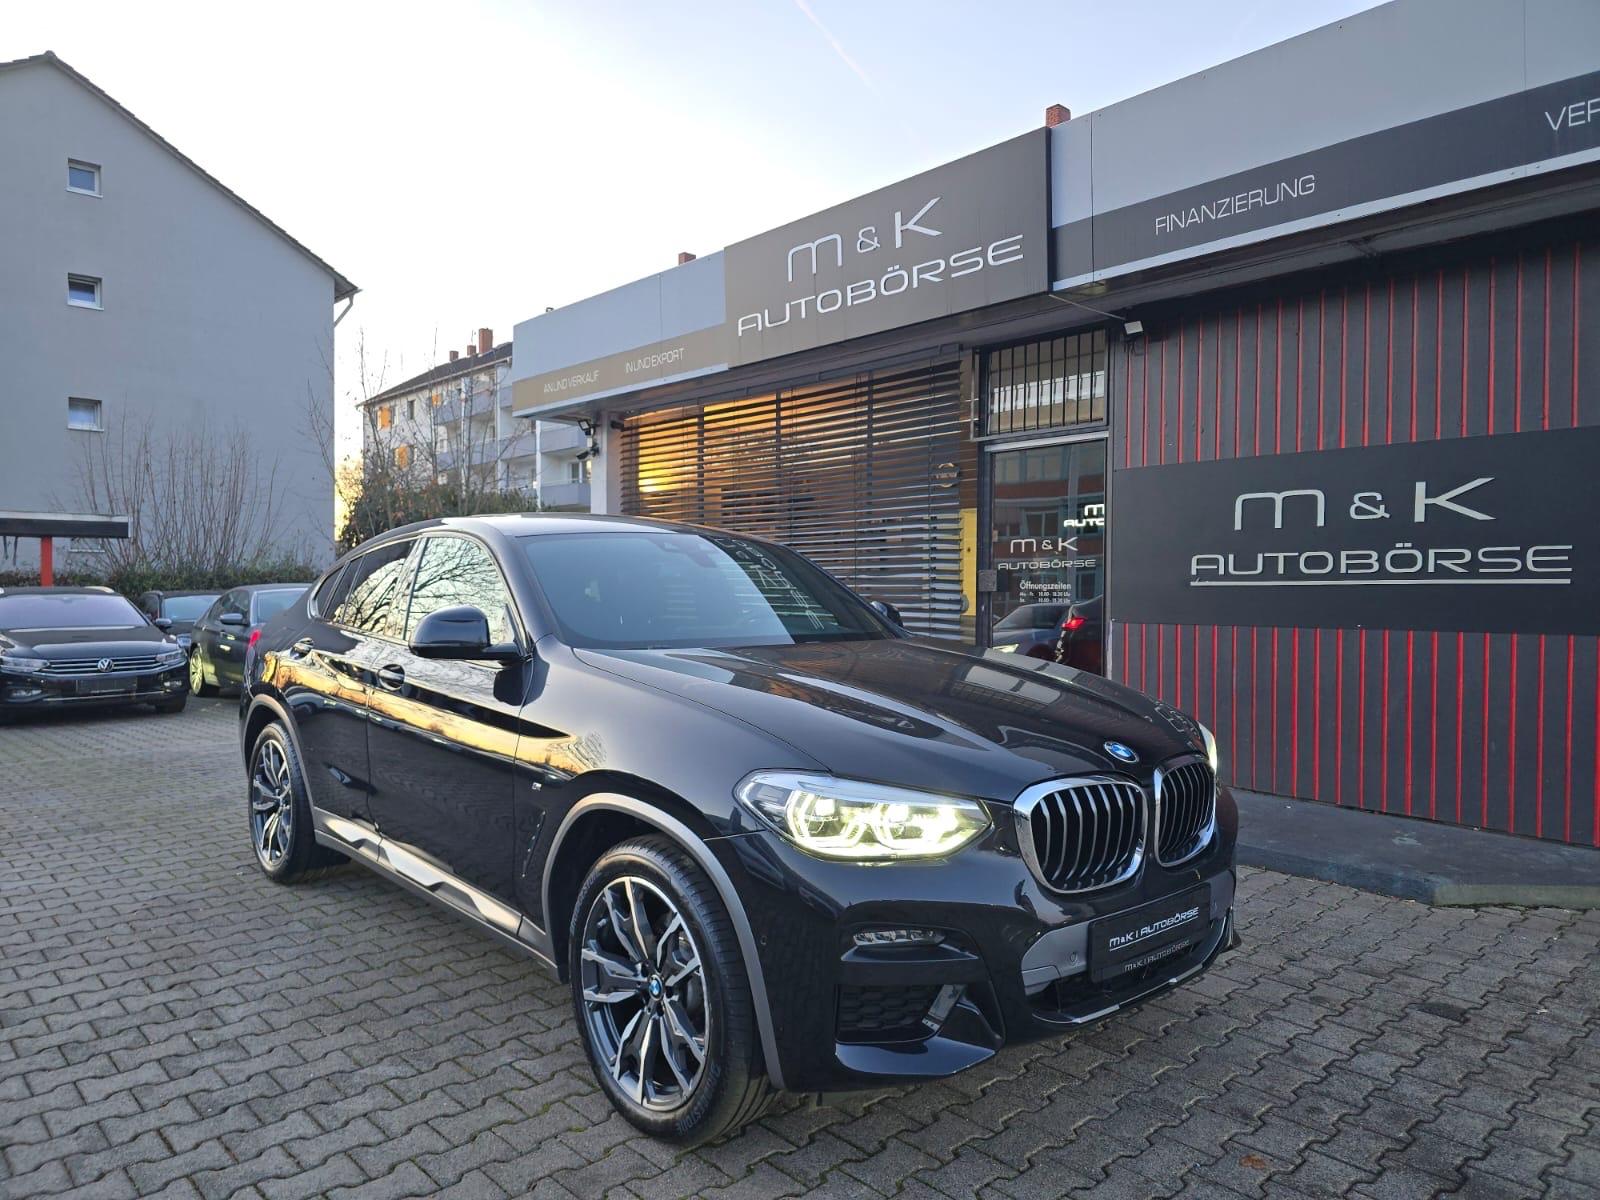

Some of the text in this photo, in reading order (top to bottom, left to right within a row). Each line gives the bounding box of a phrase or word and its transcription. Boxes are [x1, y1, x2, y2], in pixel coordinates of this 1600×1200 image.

[1155, 174, 1316, 236] FINANZIERUNG
[856, 226, 881, 253] &
[894, 196, 943, 249] K
[738, 234, 1024, 337] AUTOBÖRSE
[651, 347, 685, 368] EXPORT
[568, 369, 600, 388] VERKAUF
[1349, 491, 1391, 520] &
[1413, 477, 1497, 523] K
[1041, 539, 1054, 550] &
[1058, 536, 1079, 552] K
[1191, 542, 1573, 575] AUTOBÖRSE
[998, 559, 1097, 571] AUTOBÖRSE
[1140, 906, 1199, 937] AUTOBÖRSE
